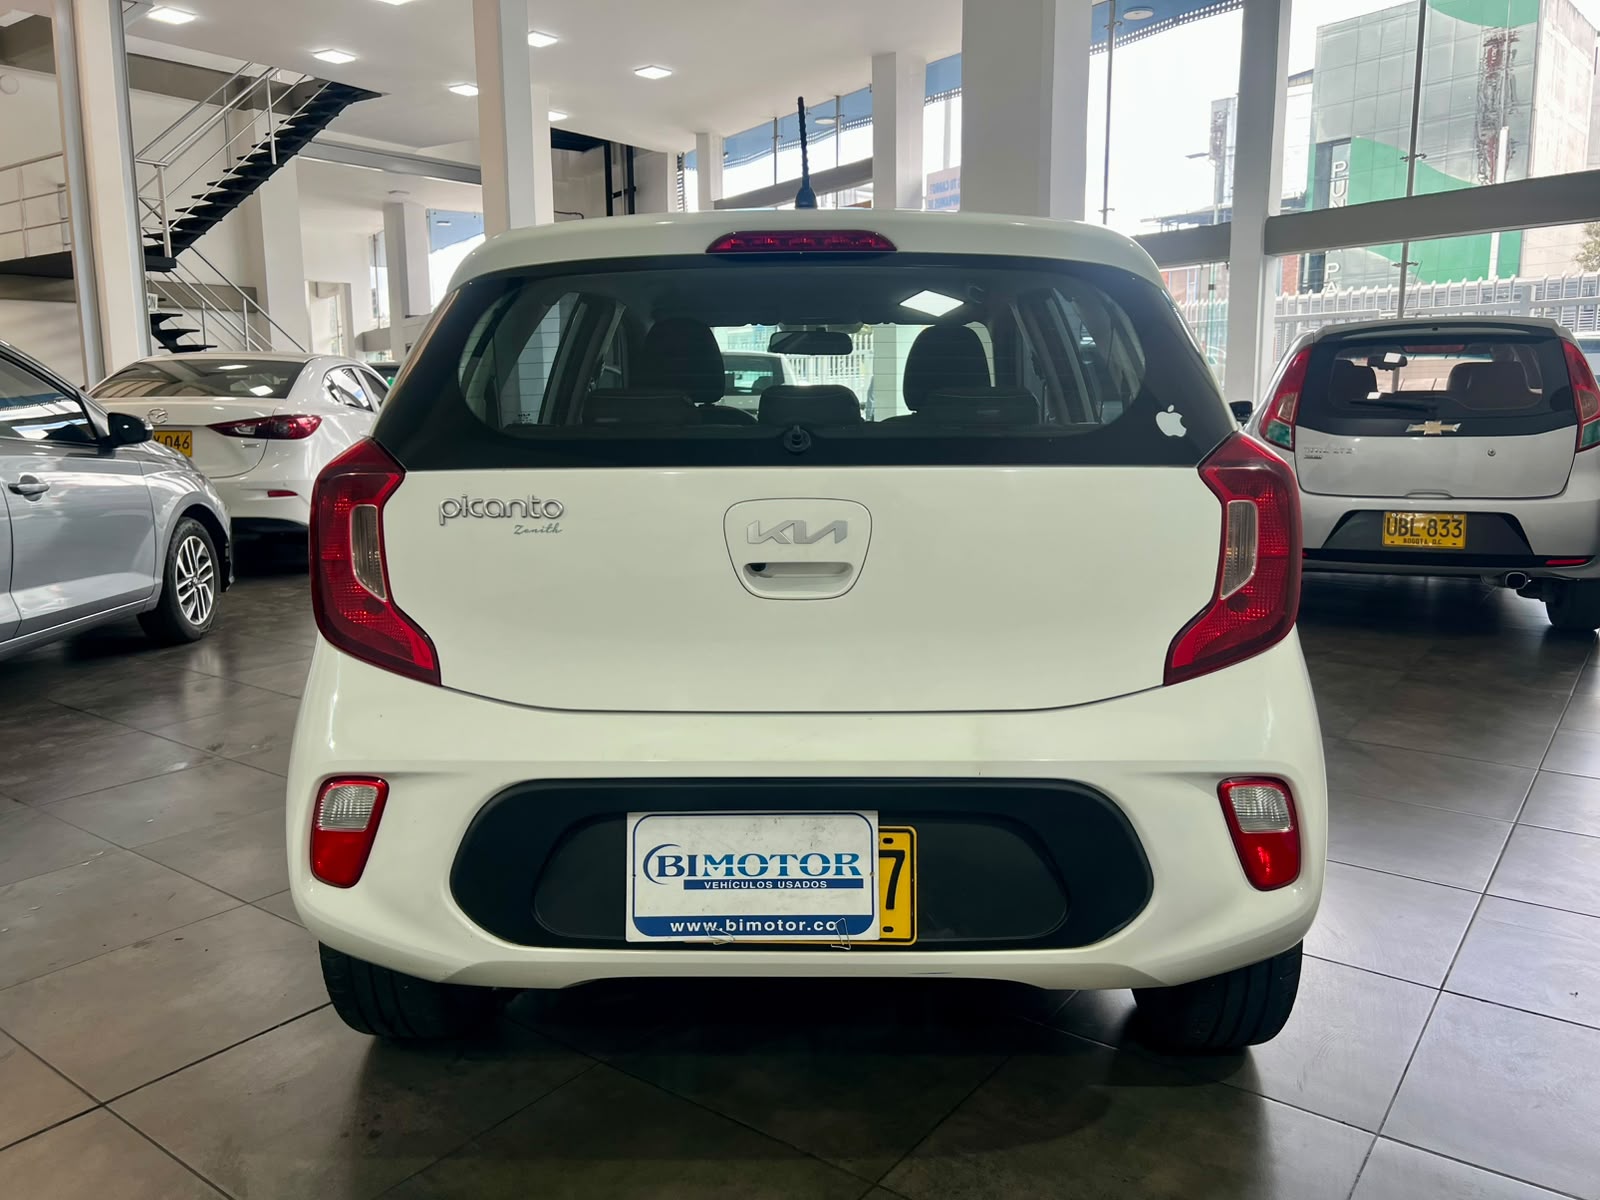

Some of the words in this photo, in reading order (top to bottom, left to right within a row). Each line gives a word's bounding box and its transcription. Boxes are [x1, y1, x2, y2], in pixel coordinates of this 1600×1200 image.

[439, 495, 564, 526] picanto
[513, 522, 563, 535] Zenith
[746, 520, 848, 544] KIA
[655, 852, 862, 878] BIMOTOR
[704, 879, 773, 889] VEHÍCULOS
[777, 880, 828, 889] USADOS
[670, 918, 837, 933] www.bimotor.co
